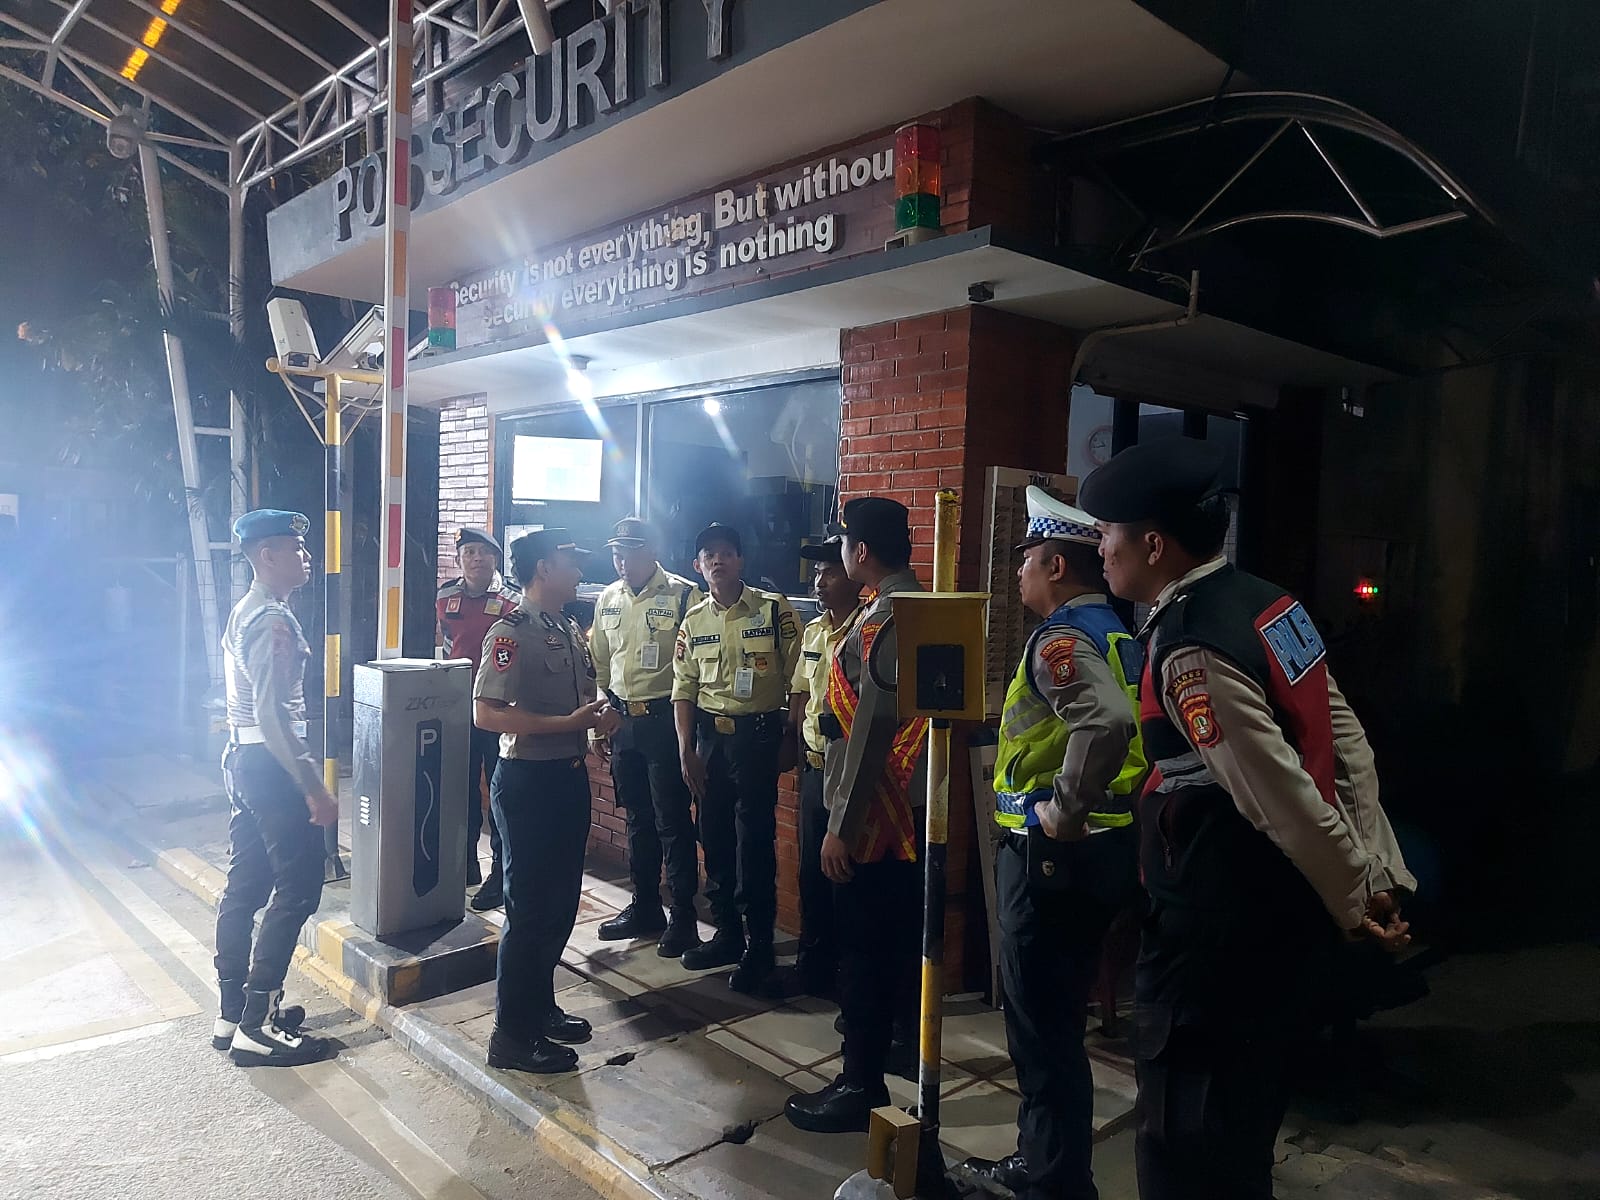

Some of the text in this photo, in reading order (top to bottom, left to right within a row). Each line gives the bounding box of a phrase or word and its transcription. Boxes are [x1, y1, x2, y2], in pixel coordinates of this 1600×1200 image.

[450, 270, 516, 307] Security
[524, 256, 540, 285] is
[543, 247, 573, 279] not
[714, 182, 767, 230] But
[775, 149, 894, 211] withou
[562, 257, 679, 310] everything
[685, 246, 708, 278] is
[720, 213, 835, 269] nothing
[1028, 474, 1051, 488] TAMU
[420, 728, 438, 757] P
